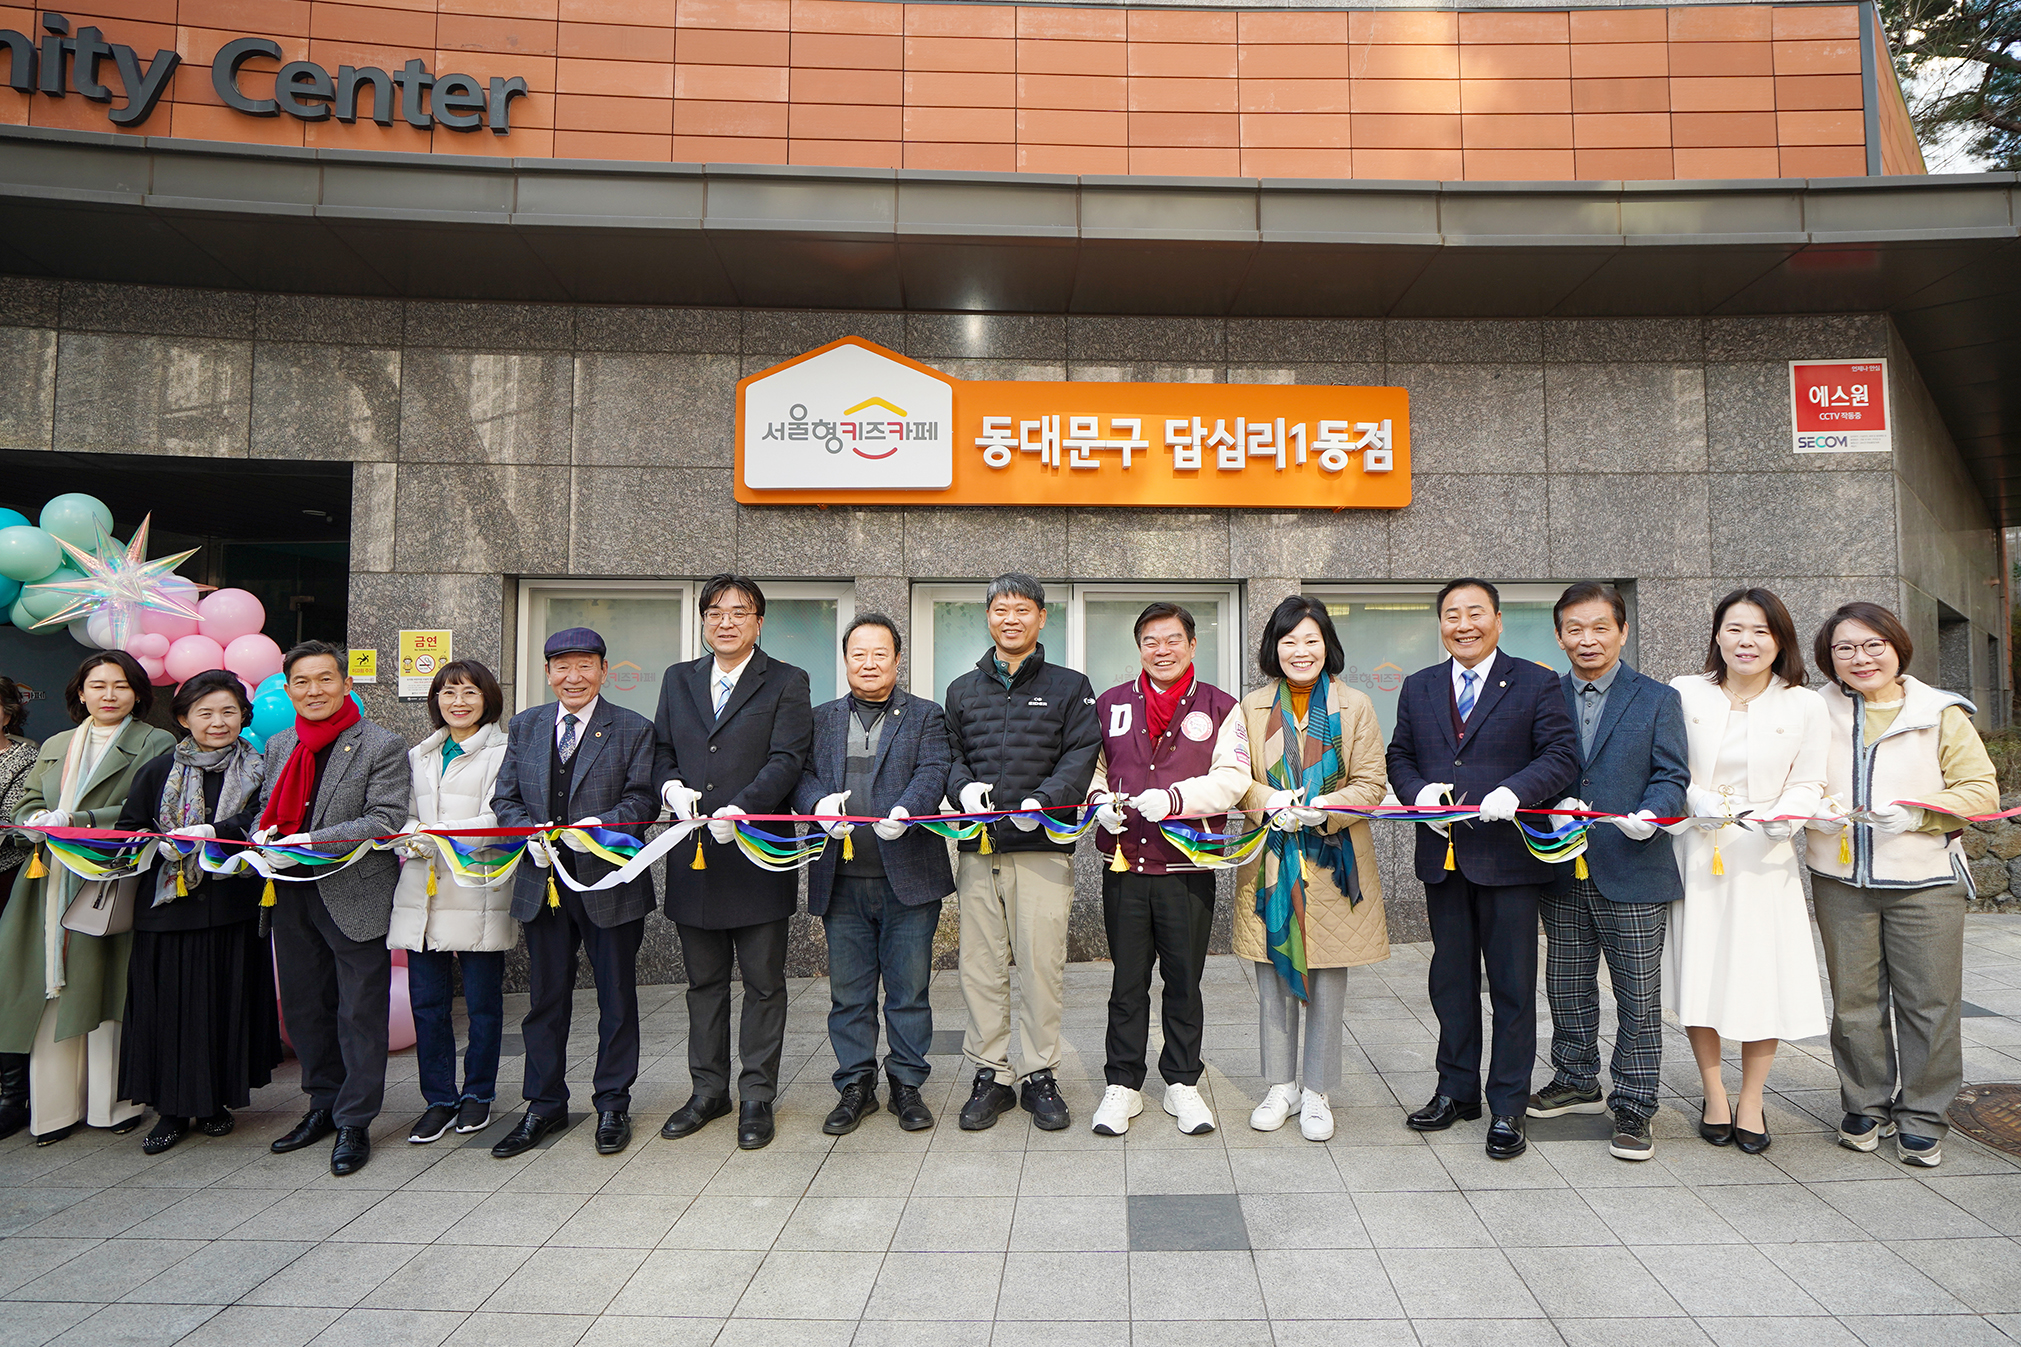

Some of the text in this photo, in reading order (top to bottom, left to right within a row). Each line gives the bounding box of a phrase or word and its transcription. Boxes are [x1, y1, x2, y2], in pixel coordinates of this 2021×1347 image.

[211, 38, 527, 136] Center
[1809, 384, 1869, 407] 에스원
[1819, 412, 1840, 421] CCTV
[762, 403, 938, 454] 서울형키즈카페
[975, 415, 1393, 472] 동대문구 답십리1동점
[1798, 436, 1848, 448] SECOM
[414, 635, 437, 648] 금연
[1339, 666, 1411, 689] 서울형키즈카
[1109, 703, 1133, 738] D
